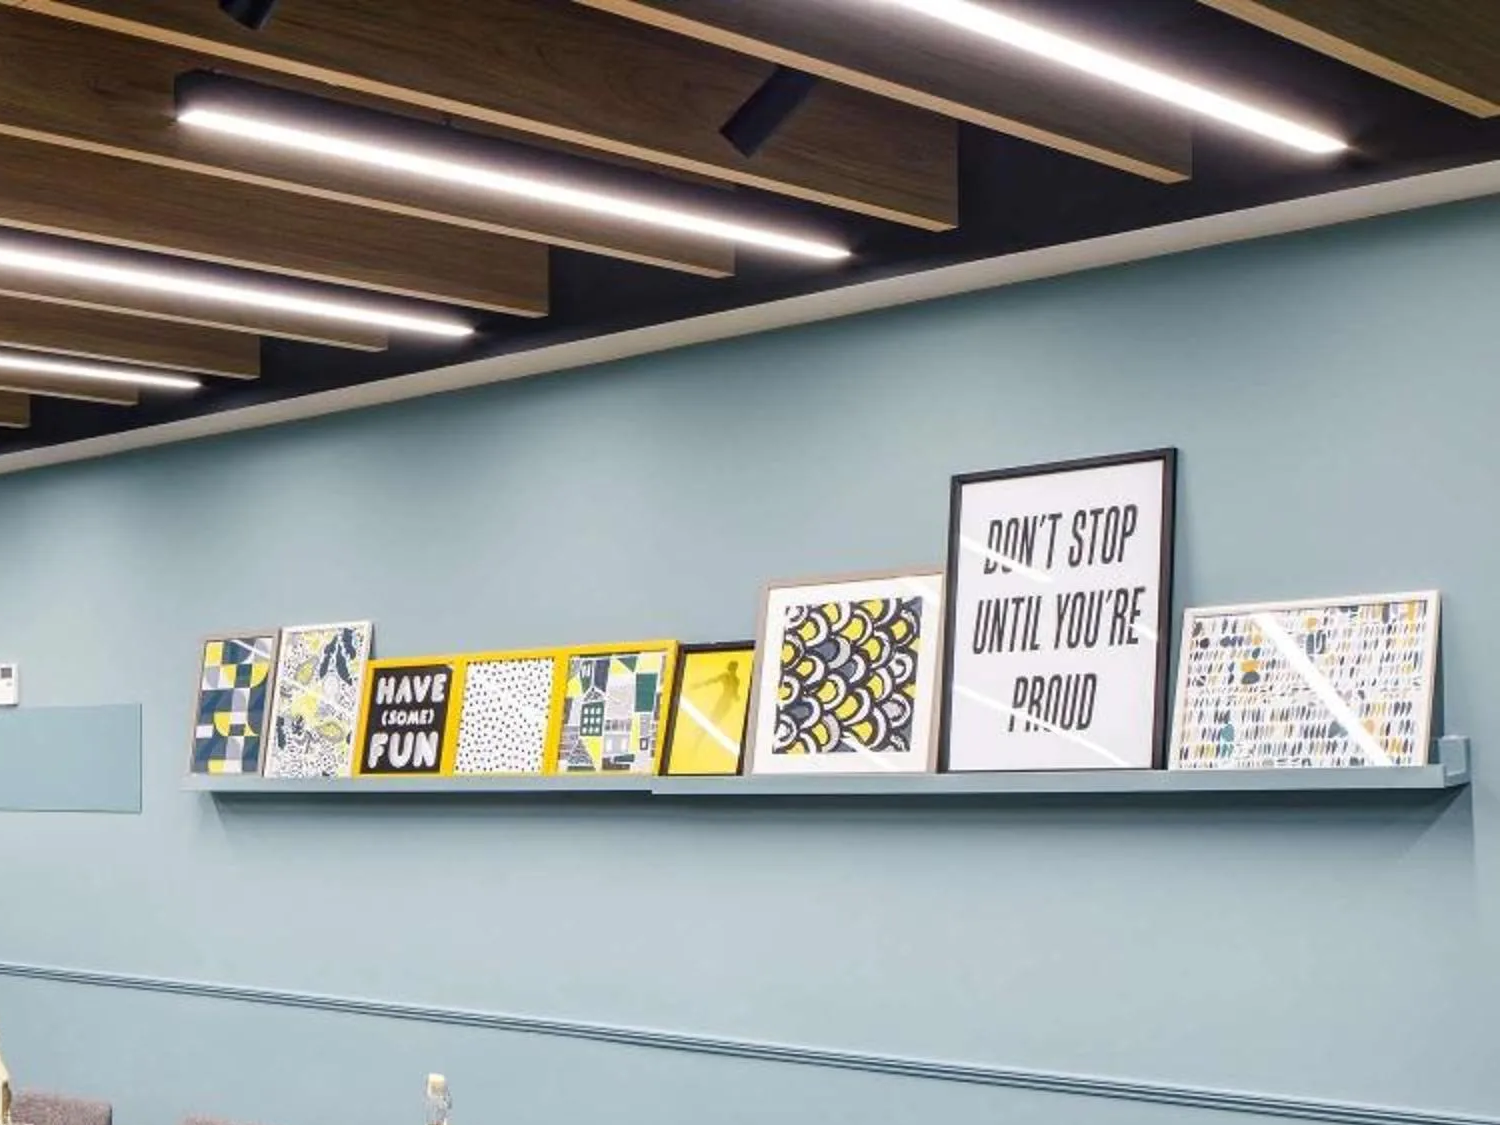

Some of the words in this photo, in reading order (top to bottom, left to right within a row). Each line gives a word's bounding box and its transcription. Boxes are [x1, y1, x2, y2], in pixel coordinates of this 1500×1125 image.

[983, 513, 1062, 575] DON'T
[1068, 504, 1138, 567] STOP
[973, 596, 1042, 655] UNTIL
[1054, 586, 1146, 650] YOU'RE
[376, 673, 447, 705] HAVE
[1008, 673, 1097, 732] PROUD
[381, 708, 435, 726] (SOME)
[367, 731, 439, 769] FUN
